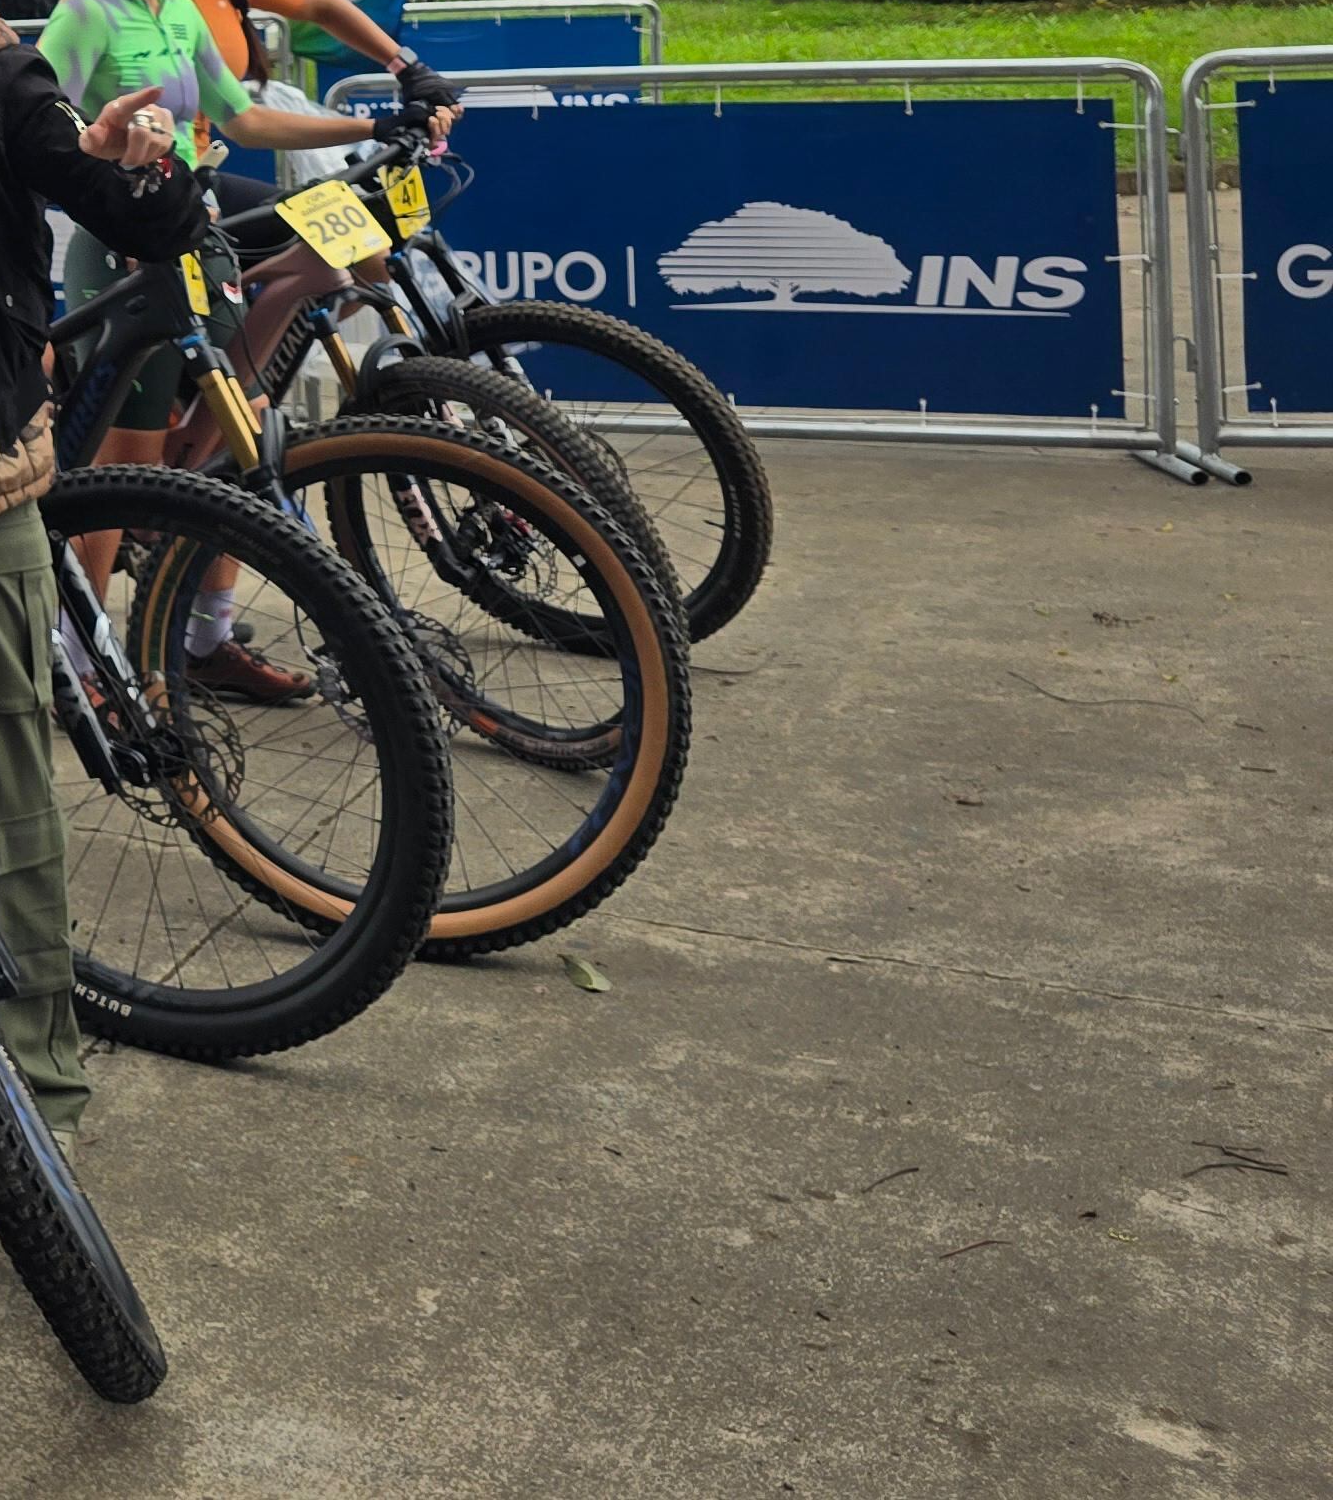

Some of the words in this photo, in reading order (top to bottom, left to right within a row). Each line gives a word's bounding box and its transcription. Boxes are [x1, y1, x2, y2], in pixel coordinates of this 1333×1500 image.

[307, 205, 367, 245] 280
[451, 251, 606, 302] RUPO
[916, 255, 1088, 310] INS
